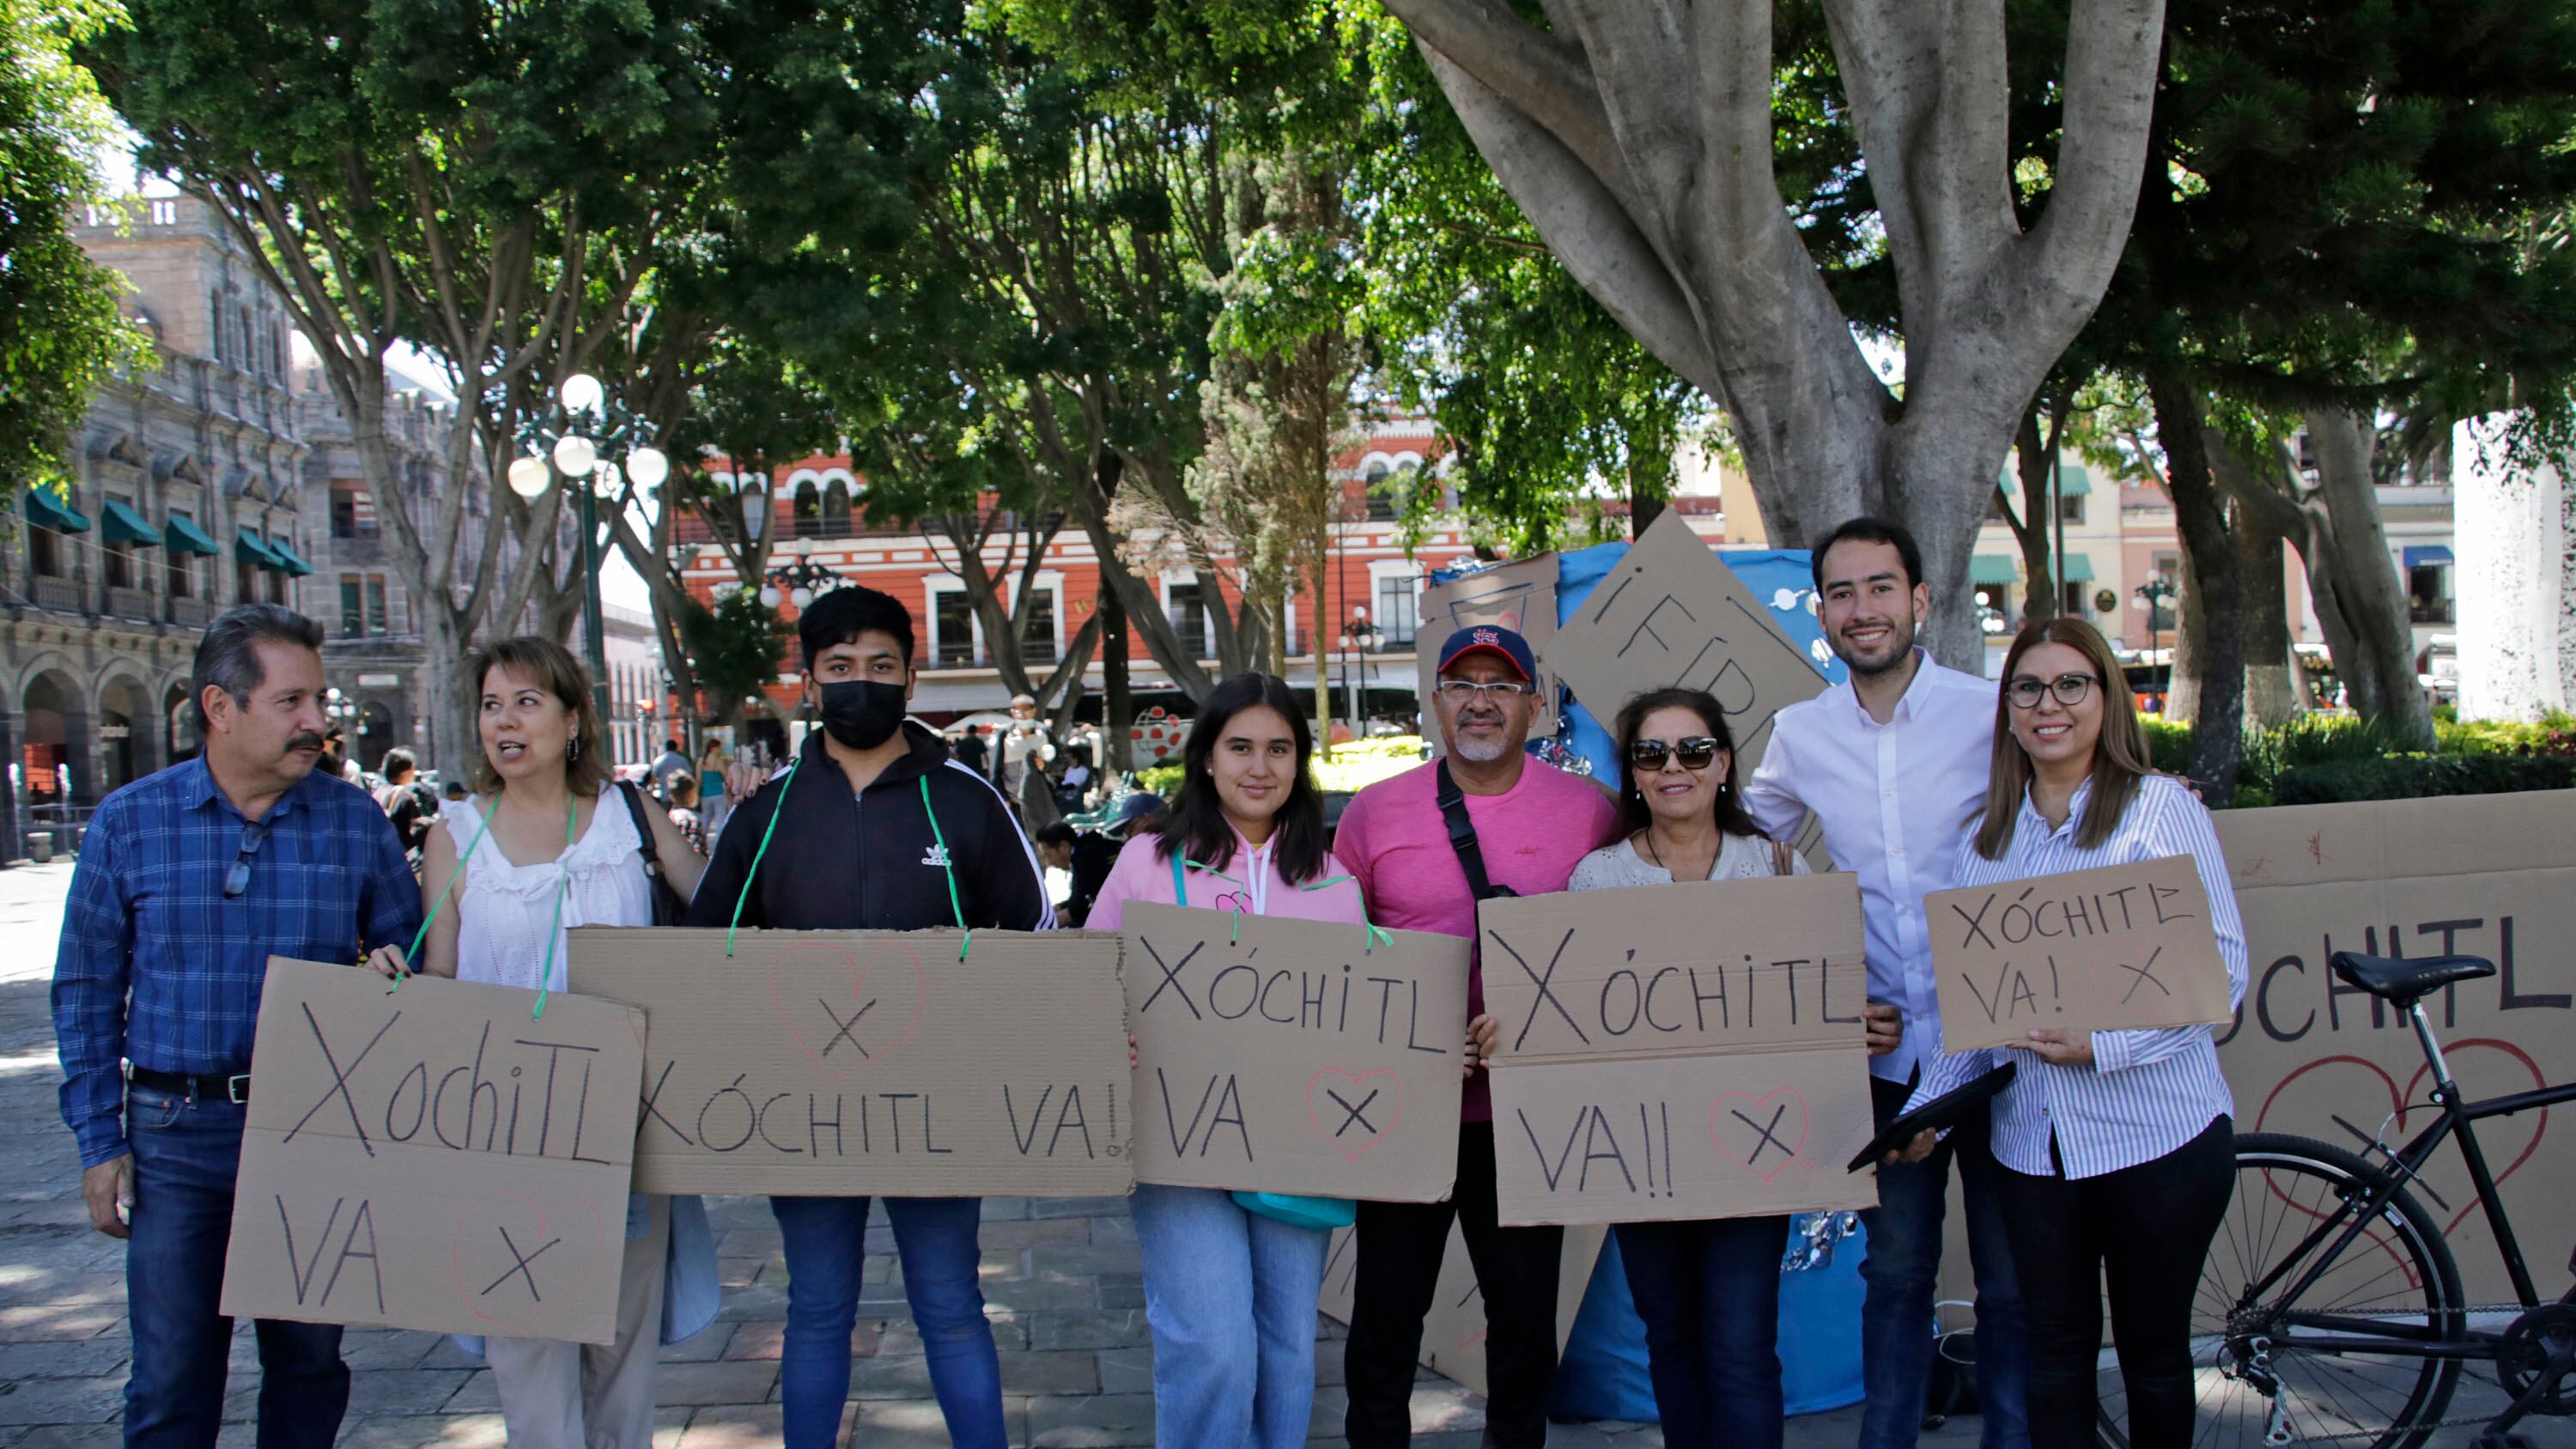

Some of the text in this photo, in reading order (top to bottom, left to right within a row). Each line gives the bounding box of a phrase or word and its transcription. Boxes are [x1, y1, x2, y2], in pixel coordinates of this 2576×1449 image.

[1962, 955, 2063, 1024] VA!
[1003, 1083, 1122, 1160] VA!
[1157, 1067, 1253, 1162] VA
[1517, 1101, 1673, 1198] VA!!
[276, 1194, 385, 1314] VA
